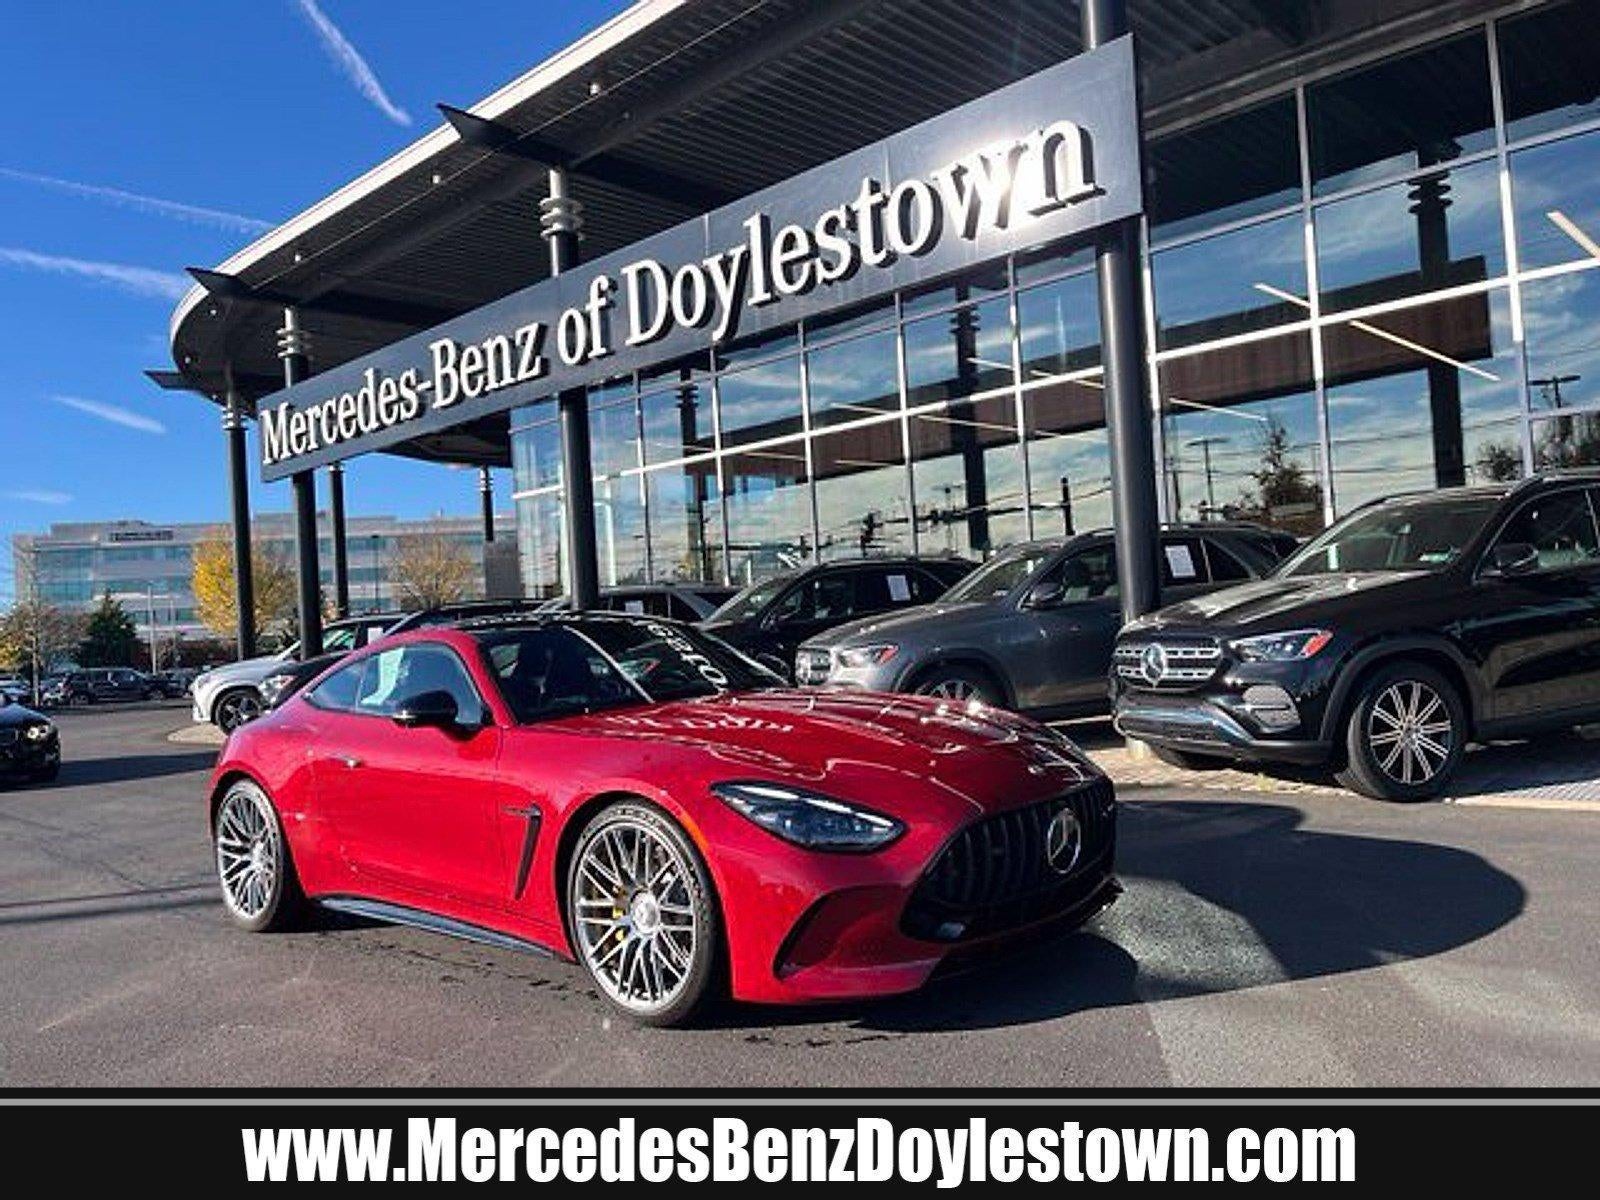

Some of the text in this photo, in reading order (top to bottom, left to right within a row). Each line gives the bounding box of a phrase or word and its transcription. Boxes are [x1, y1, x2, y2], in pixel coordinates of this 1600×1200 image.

[261, 119, 1102, 464] Mercedes-Benz of Doylestown
